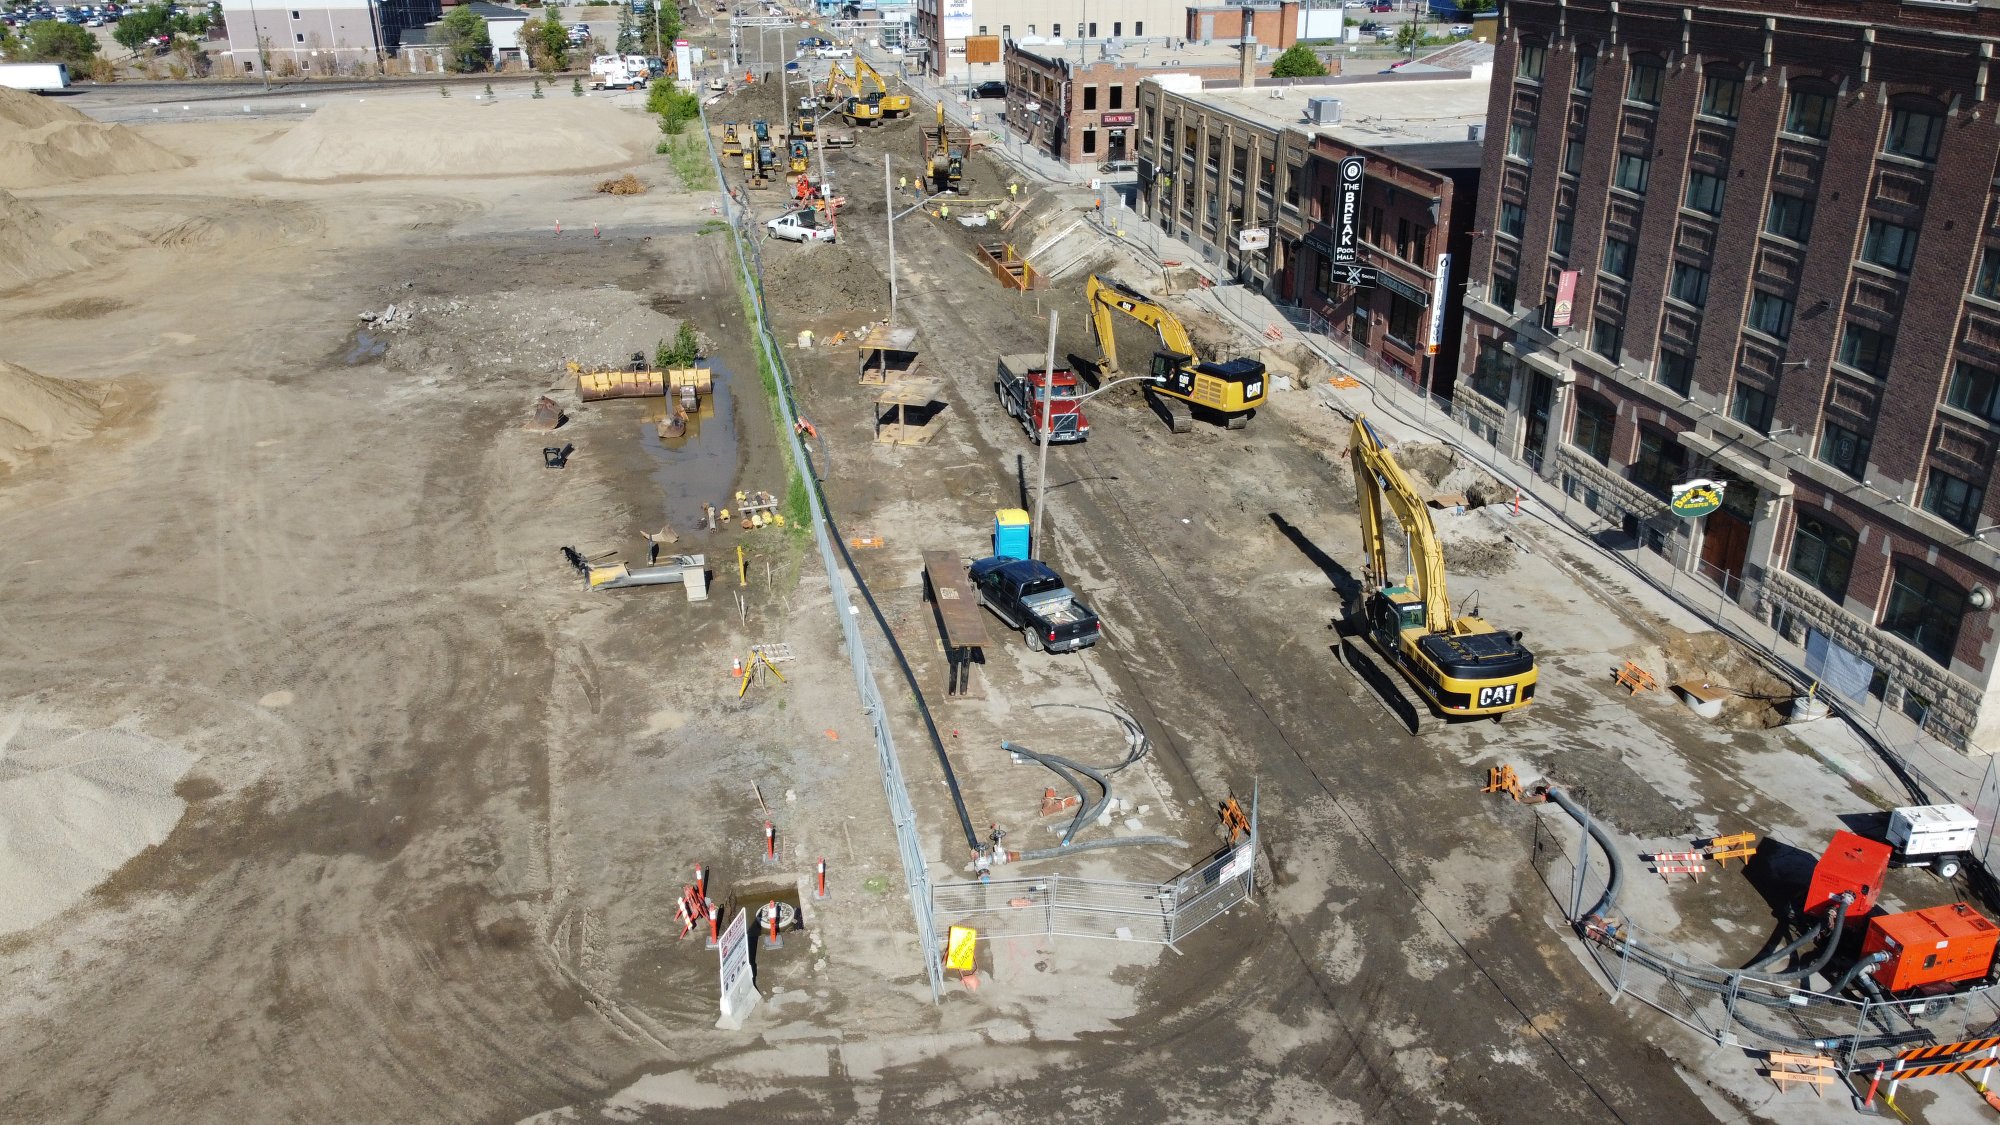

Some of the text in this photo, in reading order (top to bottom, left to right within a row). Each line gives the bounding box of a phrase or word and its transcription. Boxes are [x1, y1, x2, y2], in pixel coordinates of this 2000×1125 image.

[1343, 183, 1360, 191] THE
[1341, 192, 1355, 246] BREAK
[1122, 301, 1132, 311] CAT
[1179, 374, 1190, 384] CAT
[1246, 381, 1262, 398] CAT
[1480, 685, 1516, 706] CAT
